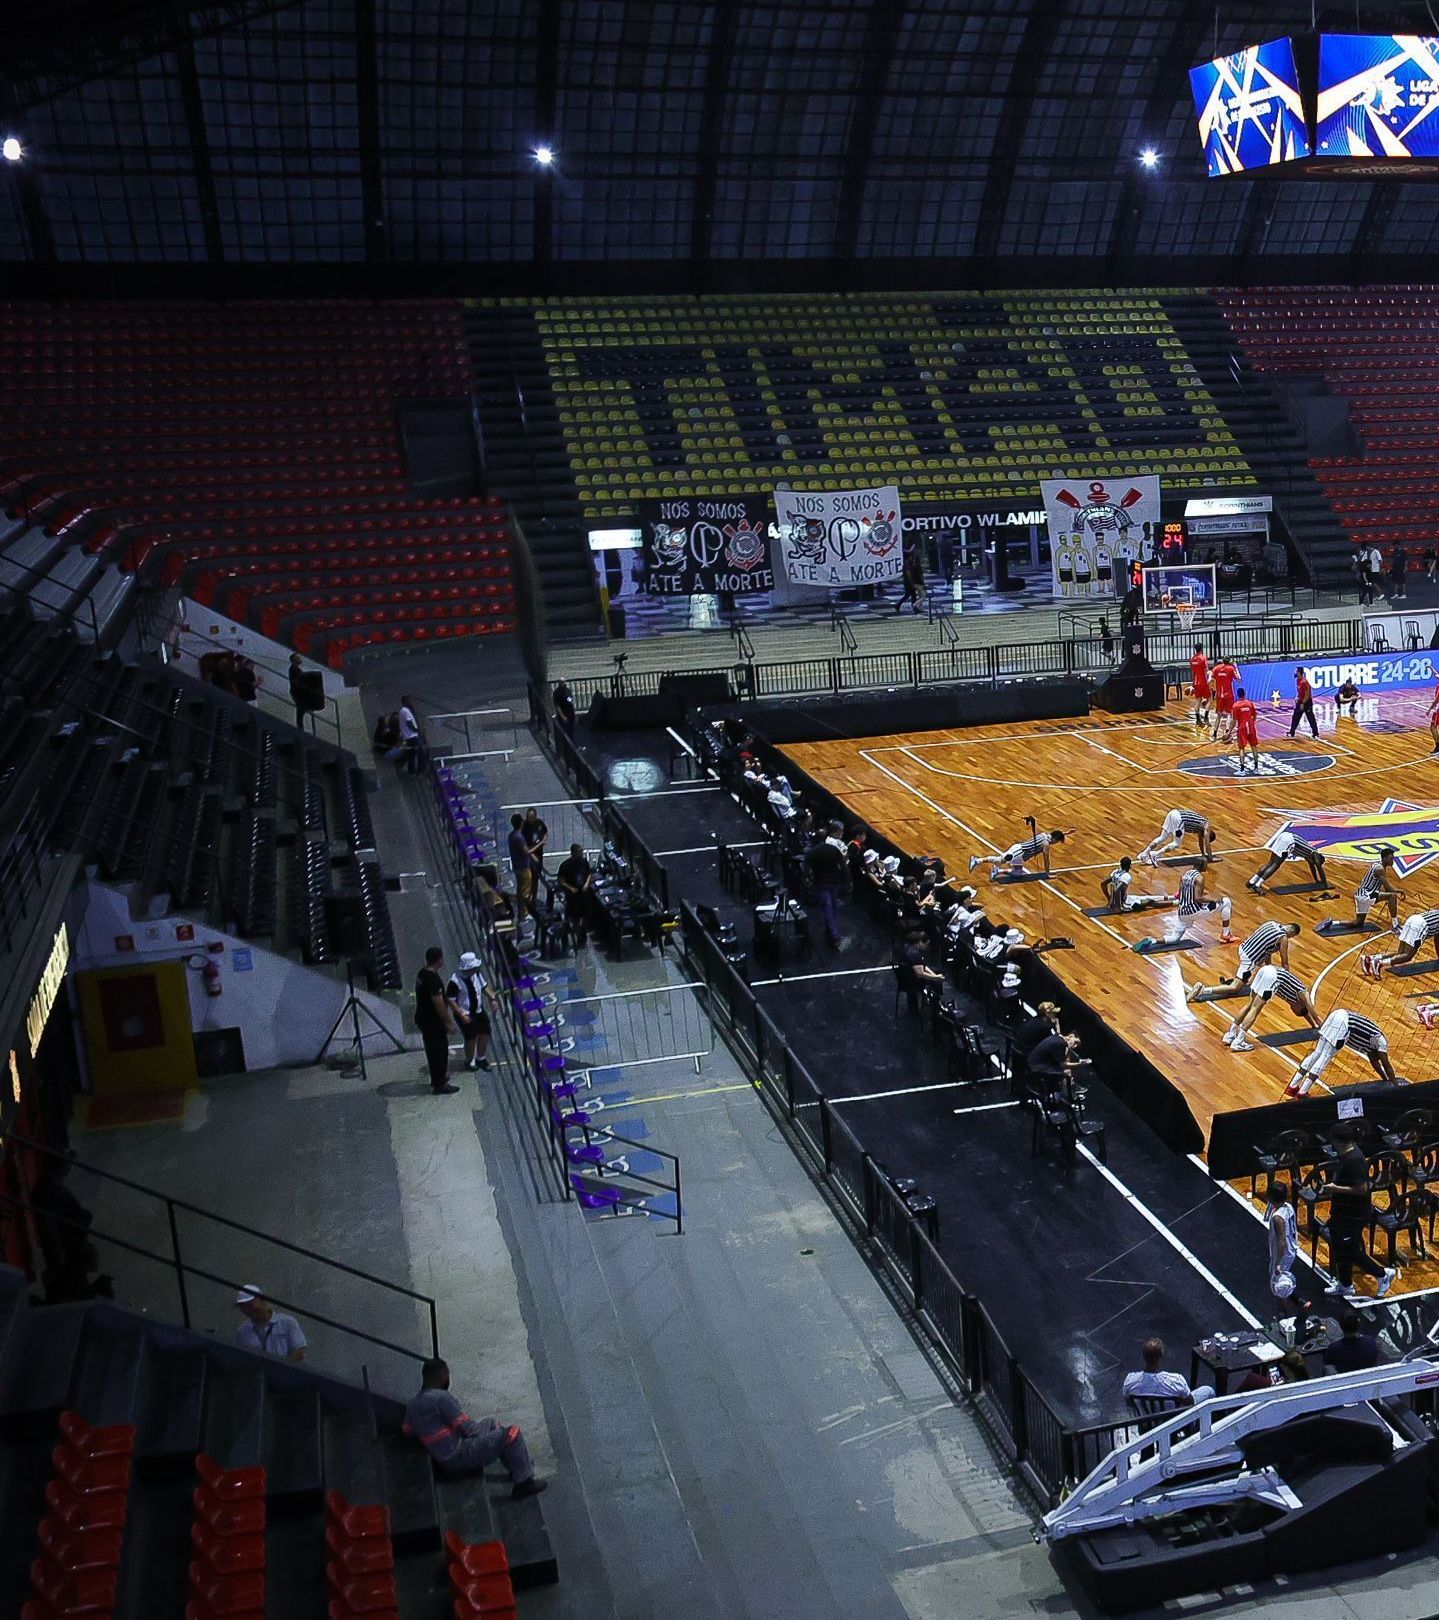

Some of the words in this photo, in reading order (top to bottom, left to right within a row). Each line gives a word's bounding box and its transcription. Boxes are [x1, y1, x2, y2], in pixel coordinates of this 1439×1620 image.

[661, 501, 690, 520] NÓS
[699, 503, 746, 519] SOMOS
[795, 496, 825, 514] NÓS
[833, 492, 881, 512] SOMOS
[1163, 533, 1183, 549] 24
[650, 573, 683, 592] ATÉ
[693, 575, 705, 591] A
[715, 570, 774, 592] MORTE
[788, 562, 818, 582] ATÉ
[828, 566, 841, 583] A
[850, 557, 904, 582] MORTE
[1381, 658, 1432, 683] 24-26
